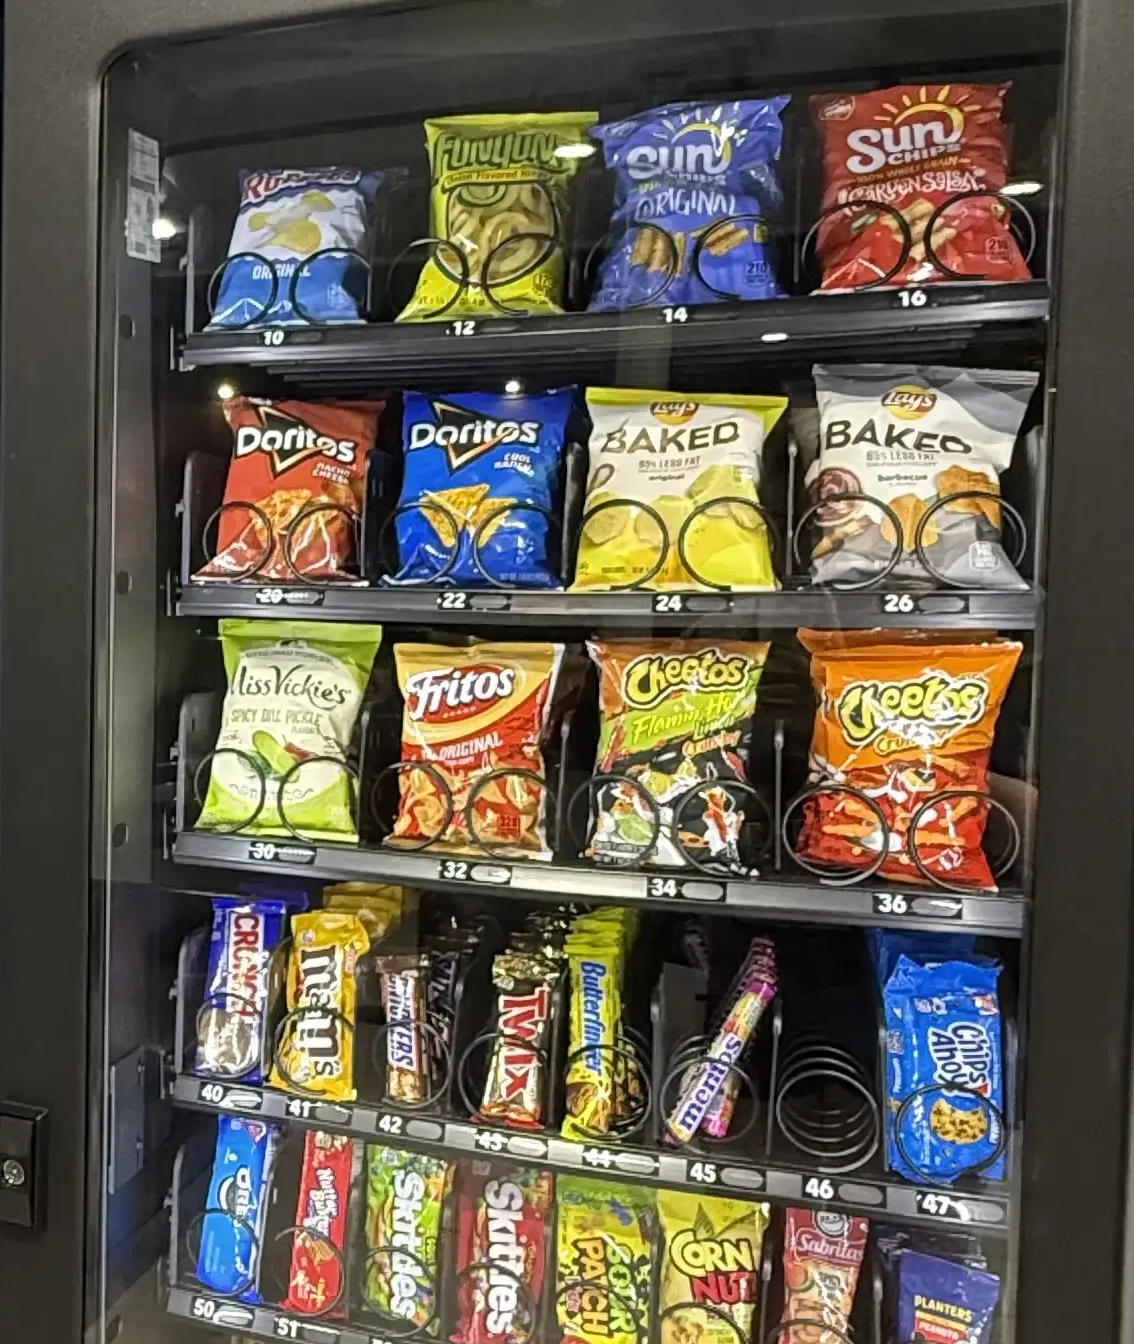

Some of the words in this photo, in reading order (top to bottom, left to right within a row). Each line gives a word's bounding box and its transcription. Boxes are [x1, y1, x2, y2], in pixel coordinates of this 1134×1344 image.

[434, 130, 572, 183] FUNYUN
[846, 120, 964, 174] Sun
[887, 143, 962, 166] CHIPS
[626, 143, 733, 180] Sun
[252, 263, 312, 281] ORGINL
[897, 289, 927, 308] 16
[662, 306, 688, 323] 14
[263, 330, 285, 346] 10
[452, 320, 476, 336] 12
[236, 424, 355, 463] Doritos
[409, 419, 539, 450] Doritos
[600, 420, 740, 454] BAKED
[825, 418, 972, 455] BAKED
[684, 455, 701, 466] FAT
[442, 592, 466, 608] 22
[655, 595, 682, 612] 24
[884, 594, 915, 612] 26
[626, 652, 745, 703] Cheetos
[405, 668, 516, 722] Fritos
[230, 708, 258, 723] SPICY
[840, 675, 984, 741] Cheetos
[438, 731, 504, 761] ORIGINAL
[251, 843, 274, 860] 30
[443, 862, 467, 879] 32
[650, 880, 677, 897] 34
[878, 896, 907, 913] 36
[503, 989, 547, 1099] TWIX
[950, 1024, 988, 1085] Chips
[201, 1085, 223, 1103] 40
[288, 1101, 310, 1118] 41
[378, 1116, 402, 1134] 42
[689, 1162, 717, 1182] 45
[804, 1180, 835, 1200] 46
[922, 1193, 951, 1215] 47
[669, 1228, 756, 1276] CORN
[605, 1243, 637, 1333] SOUR
[192, 1298, 215, 1317] 50
[914, 1294, 973, 1324] PLANTERS
[277, 1316, 298, 1335] 51
